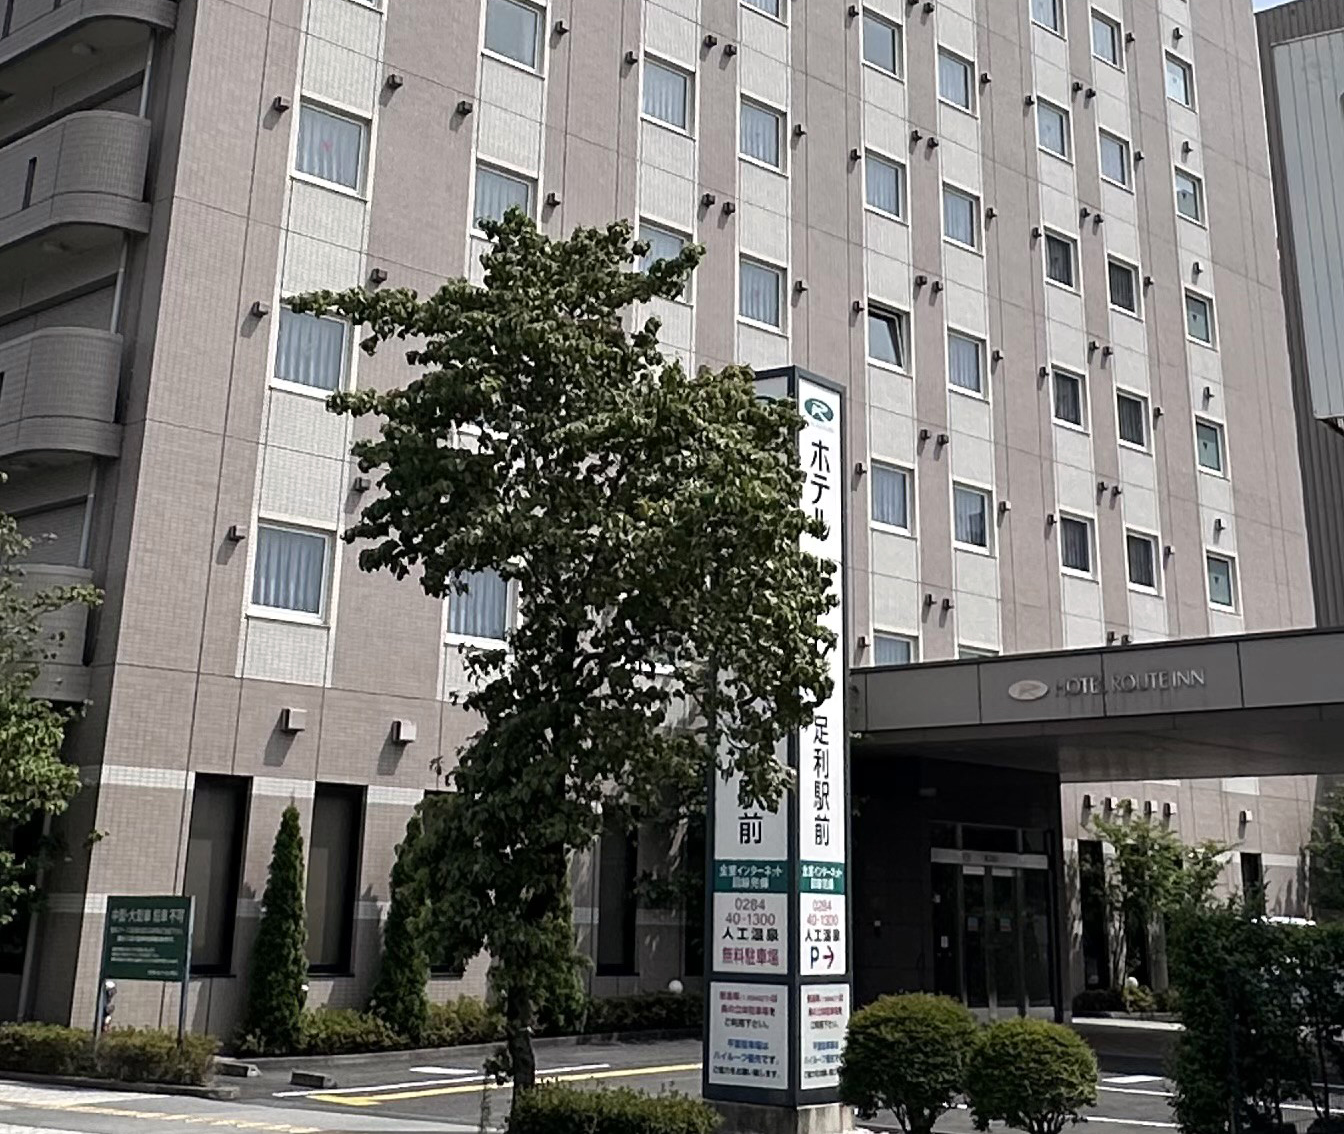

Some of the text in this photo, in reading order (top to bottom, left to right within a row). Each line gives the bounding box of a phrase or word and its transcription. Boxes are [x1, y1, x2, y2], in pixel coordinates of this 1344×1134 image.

[1111, 670, 1168, 693] ROUTE
[1172, 669, 1205, 687] INN
[813, 716, 830, 845] 足利駅前
[735, 898, 766, 911] 0284
[812, 899, 832, 912] 0284
[722, 926, 779, 942] 人工温泉
[722, 947, 780, 966] 無料駐車場
[810, 946, 820, 969] P
